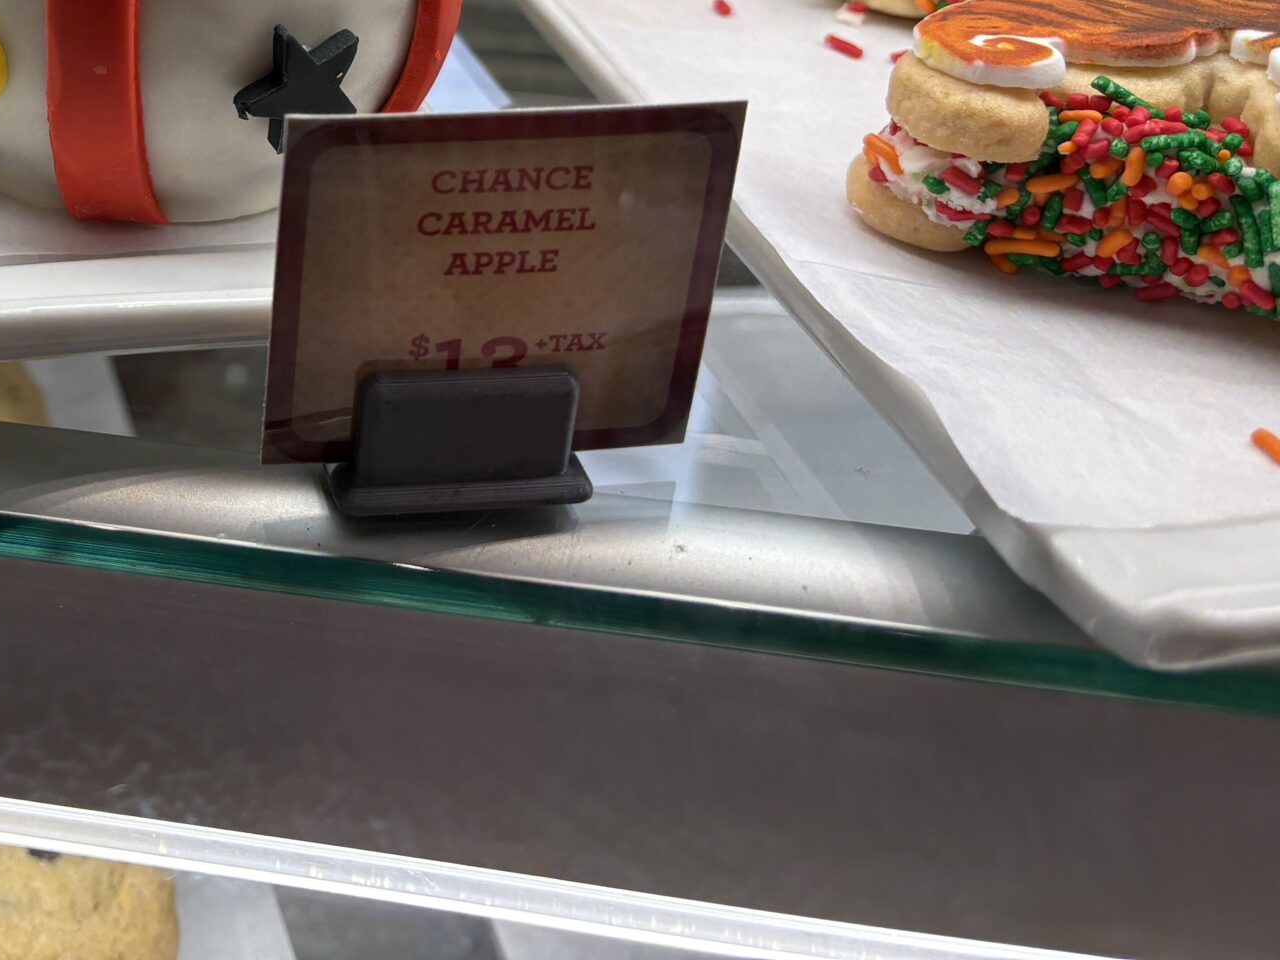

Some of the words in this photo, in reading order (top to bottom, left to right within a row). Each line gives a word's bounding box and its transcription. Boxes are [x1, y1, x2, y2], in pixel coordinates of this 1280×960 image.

[431, 165, 595, 195] CHANCE
[417, 207, 596, 236] CARAMEL
[443, 249, 559, 276] APPLE
